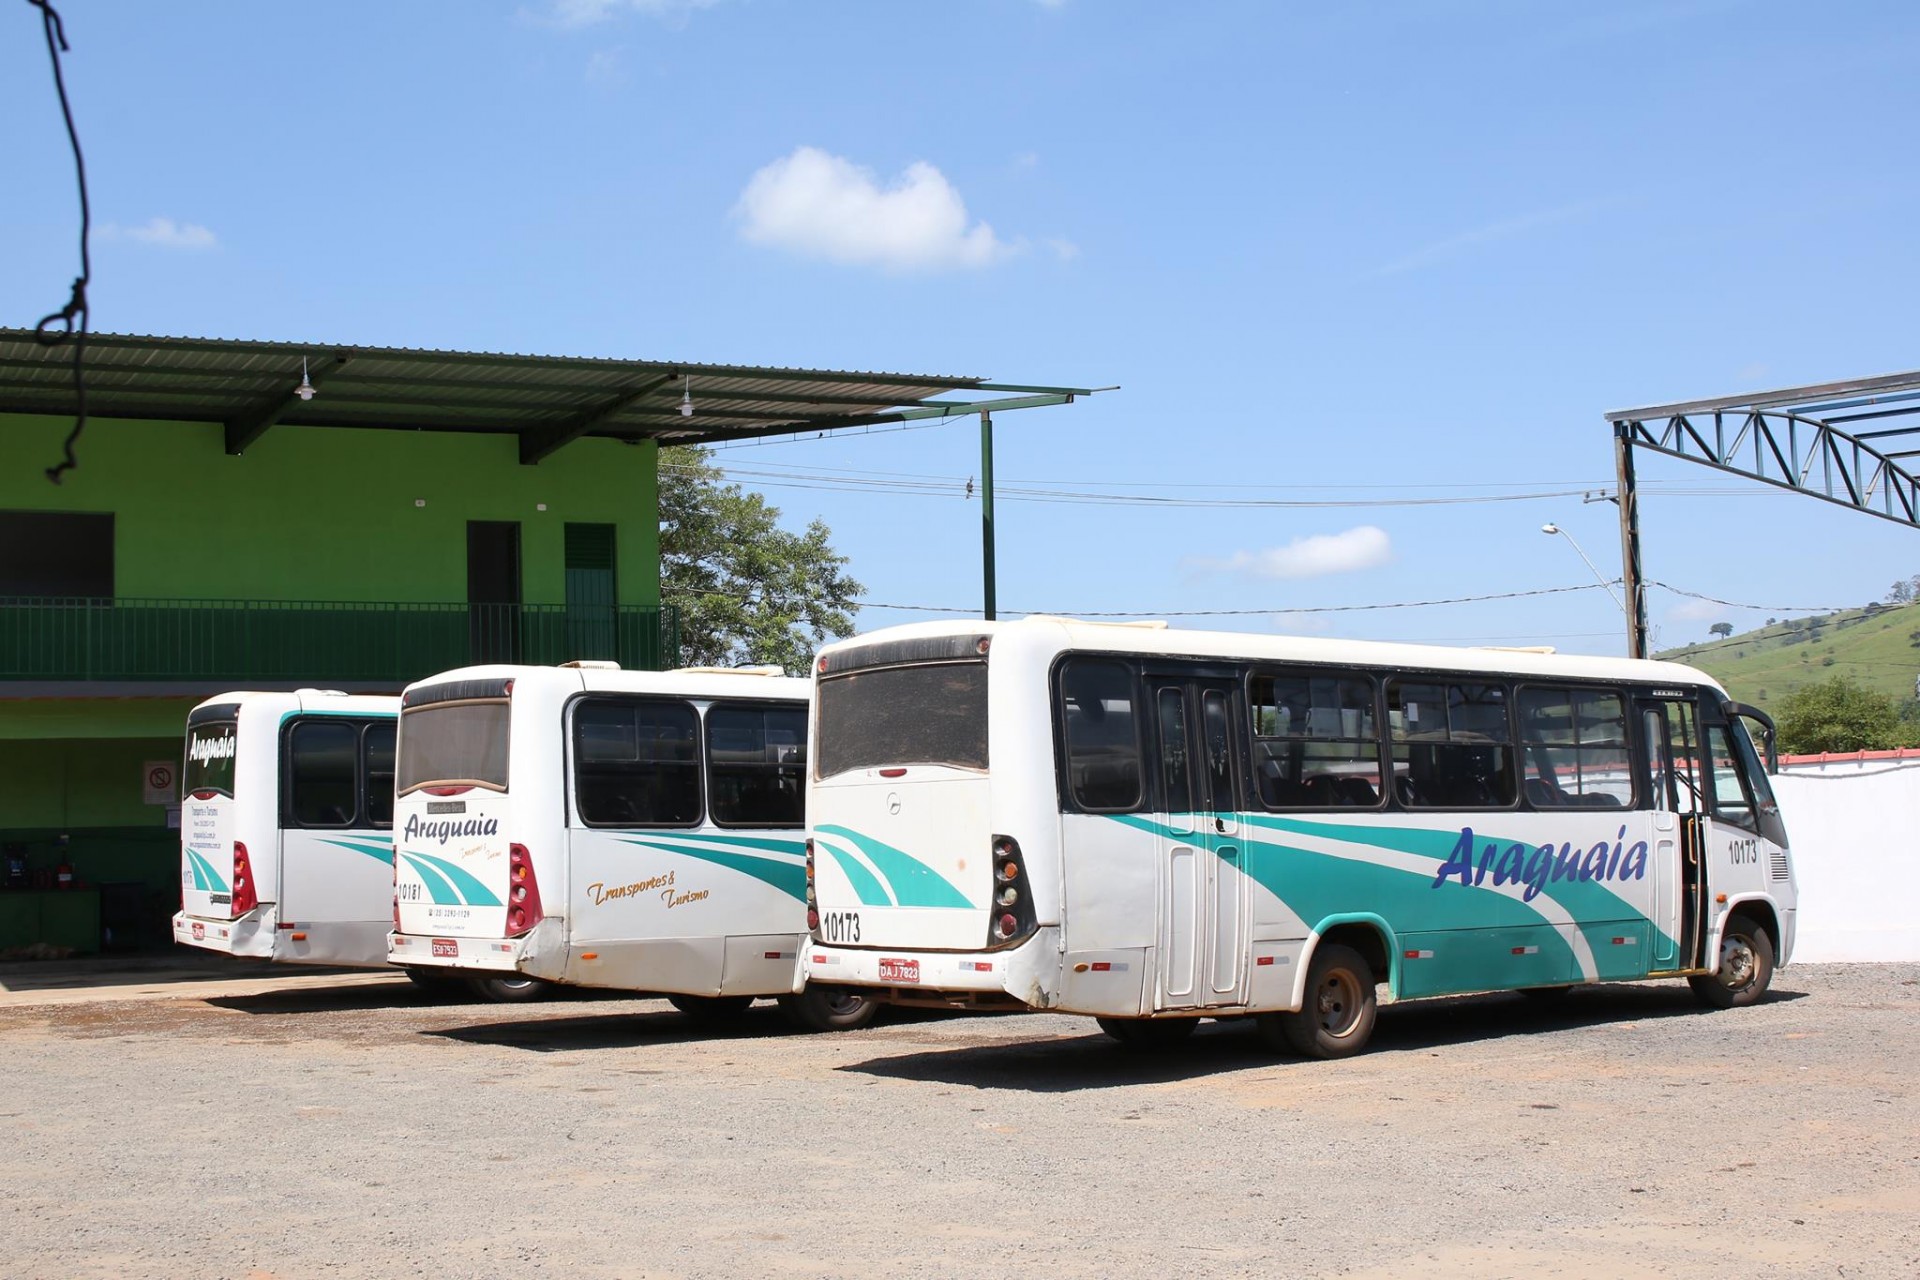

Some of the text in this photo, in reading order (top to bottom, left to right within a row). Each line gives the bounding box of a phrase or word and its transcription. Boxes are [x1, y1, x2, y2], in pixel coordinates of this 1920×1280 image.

[189, 728, 235, 768] Araguaia
[404, 812, 499, 845] Araguaia
[1431, 824, 1648, 902] Araguaia
[1728, 839, 1757, 864] 10173
[399, 883, 421, 900] 10181
[587, 870, 675, 906] Transportes &
[661, 889, 709, 909] Turismo
[824, 912, 861, 942] 10173
[880, 966, 918, 979] DAJ 7823
